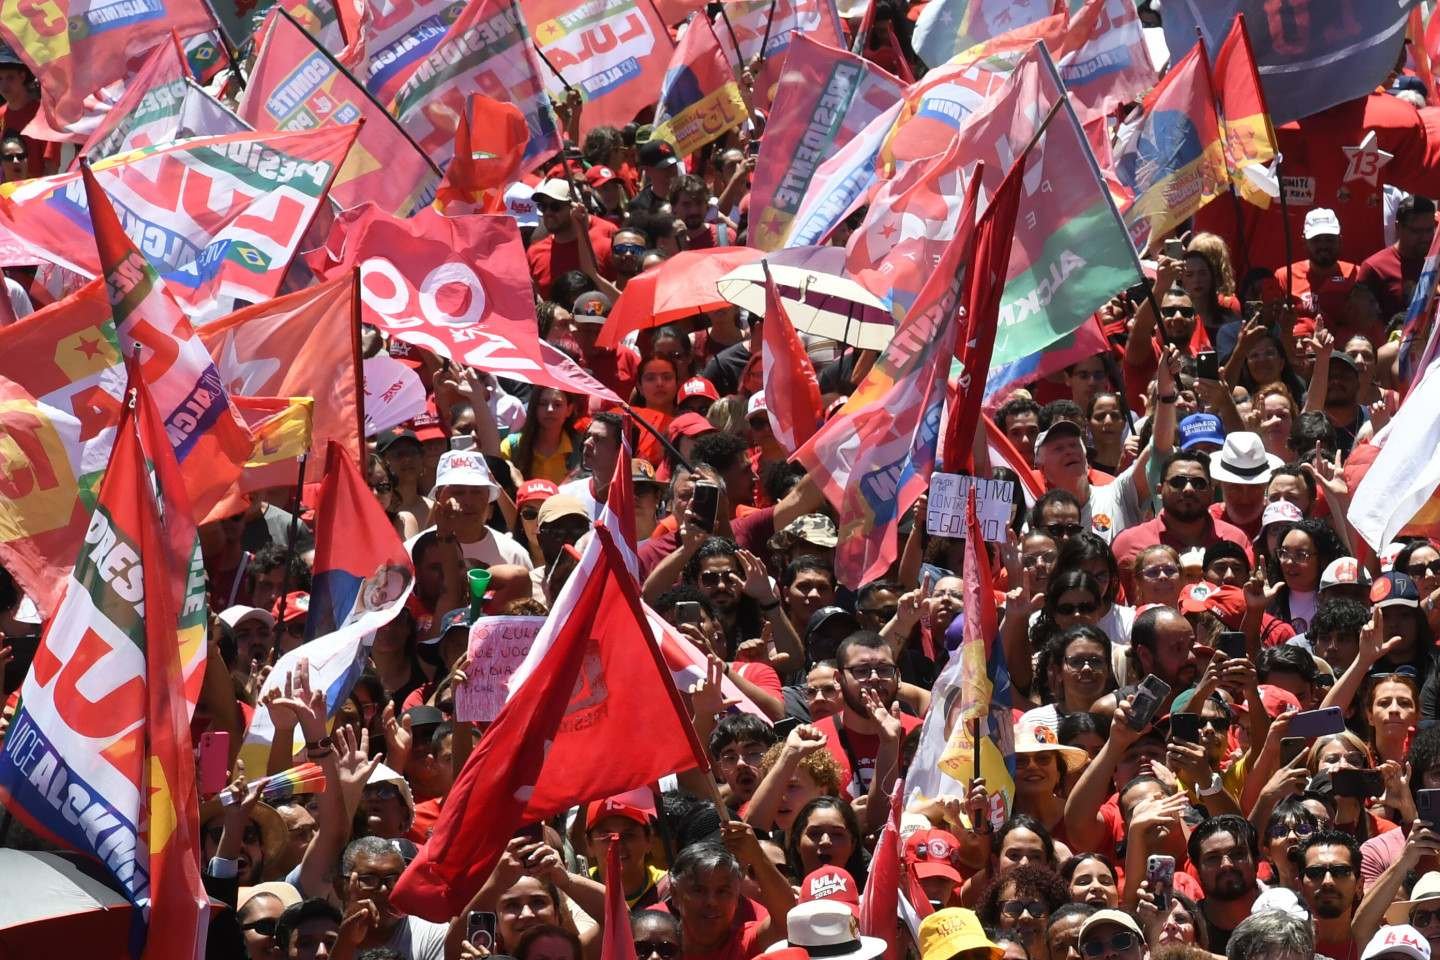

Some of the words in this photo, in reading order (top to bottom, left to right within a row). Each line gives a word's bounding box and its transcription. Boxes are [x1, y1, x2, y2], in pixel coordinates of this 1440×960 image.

[1352, 151, 1380, 176] 13
[6, 717, 44, 779] VICE
[811, 873, 844, 896] LULA
